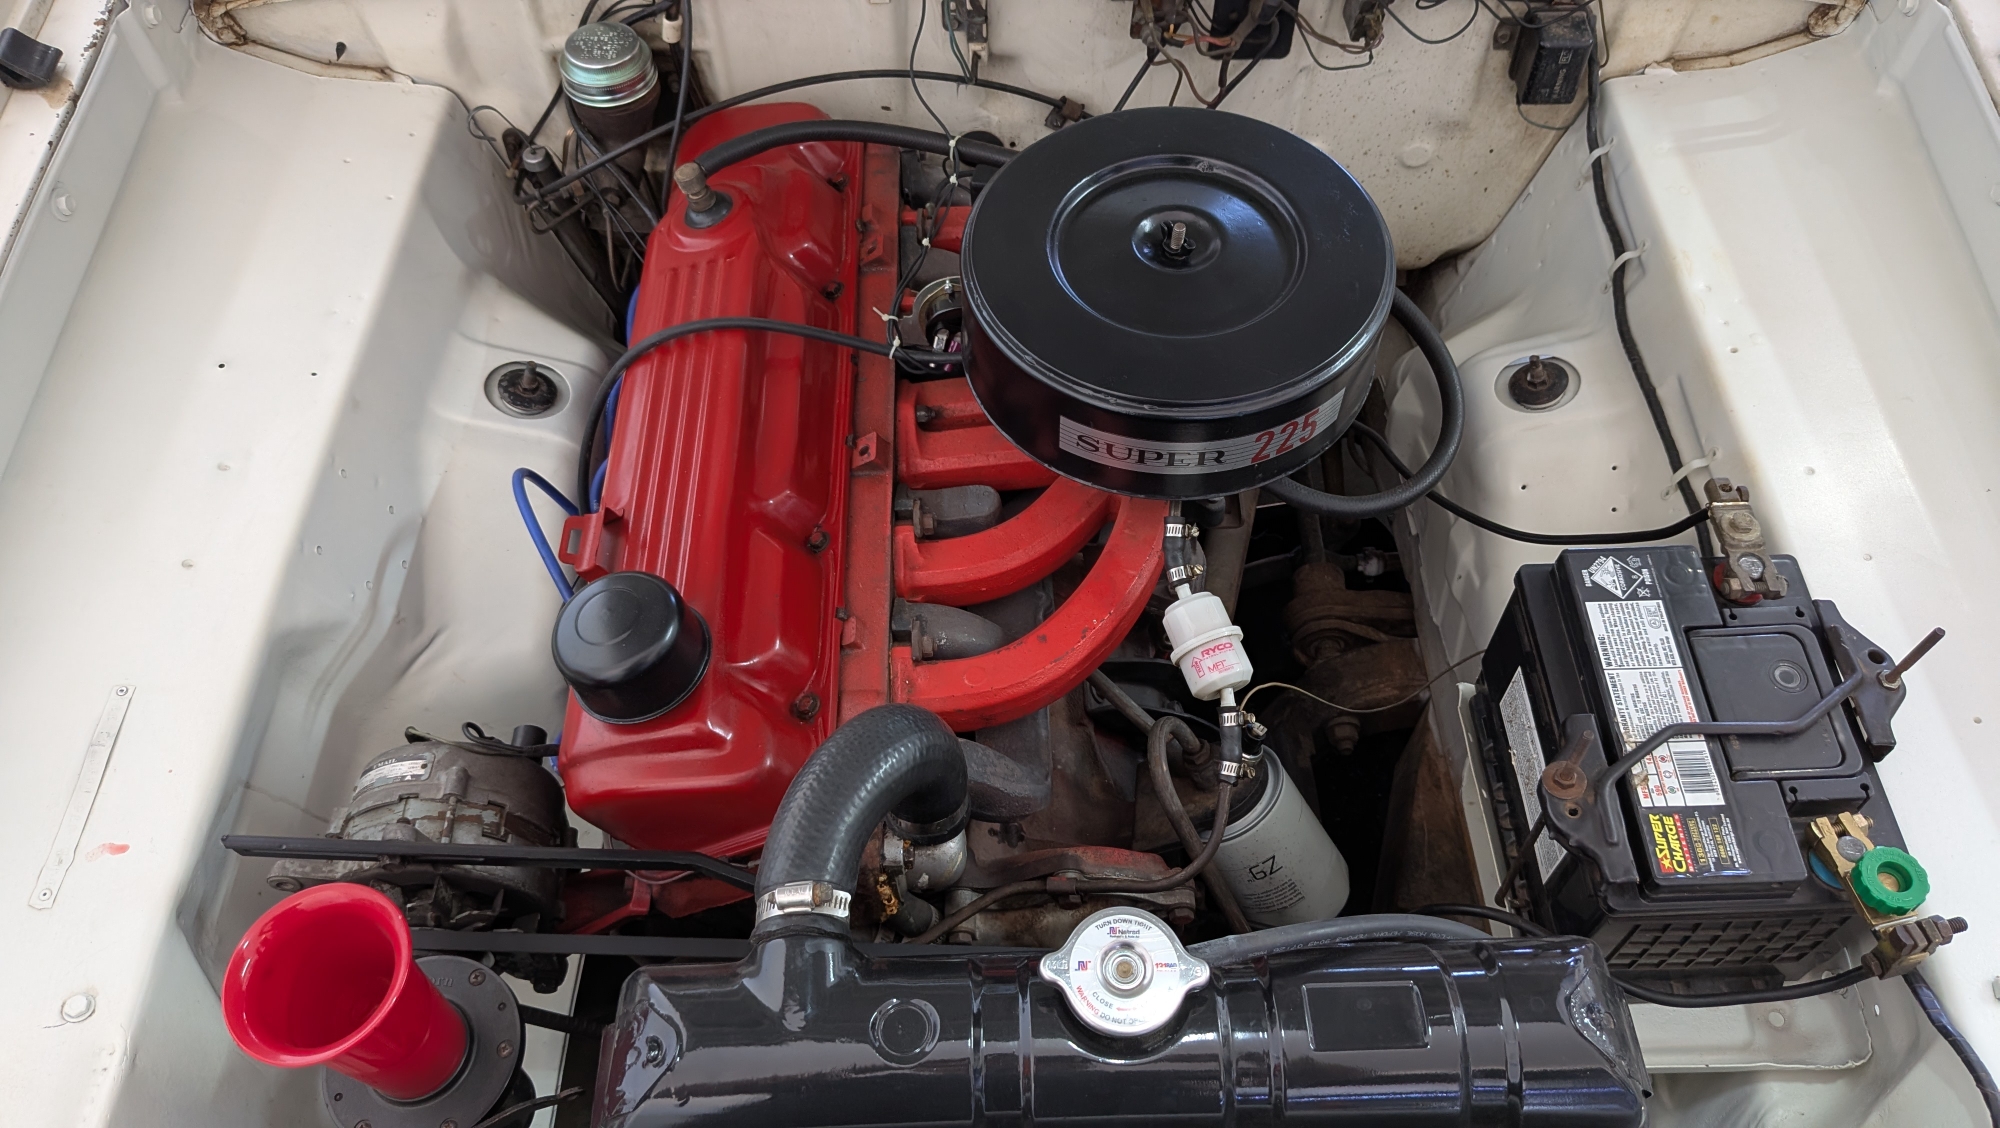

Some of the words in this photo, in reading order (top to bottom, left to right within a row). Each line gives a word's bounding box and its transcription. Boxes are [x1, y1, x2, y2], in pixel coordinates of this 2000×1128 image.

[1076, 434, 1227, 467] SUPER
[1251, 408, 1320, 464] 225
[1588, 556, 1606, 573] UN2794
[1615, 564, 1627, 590] CORROSIVE
[1642, 569, 1653, 584] POISON
[1582, 570, 1592, 587] DANGER
[1201, 642, 1233, 657] RYCO
[1598, 634, 1613, 667] WARNING:
[1607, 672, 1623, 706] STATEMENT
[1649, 813, 1671, 859] SUPER
[1663, 816, 1687, 872] CHARGE
[1673, 813, 1695, 871] BATTERIES
[1696, 842, 1705, 862] 1300
[1095, 920, 1112, 931] TURN
[1134, 920, 1152, 931] TIGHT
[1076, 985, 1100, 1015] WARNING
[1100, 1012, 1110, 1020] DO
[1111, 1016, 1127, 1025] NOT
[1092, 991, 1114, 1009] CLOSE
